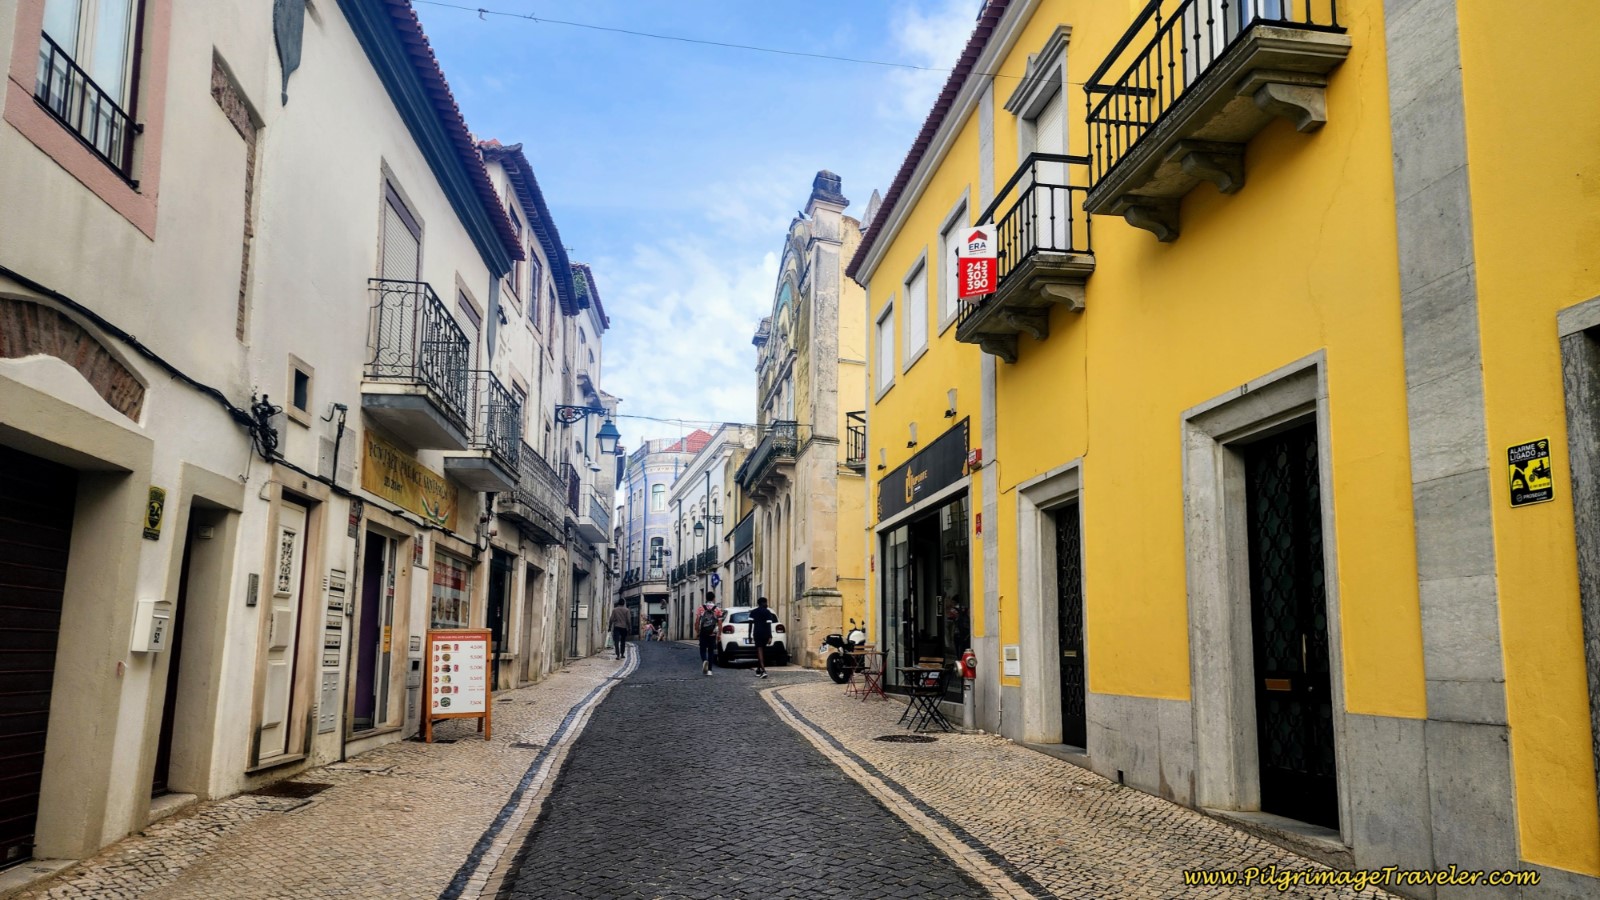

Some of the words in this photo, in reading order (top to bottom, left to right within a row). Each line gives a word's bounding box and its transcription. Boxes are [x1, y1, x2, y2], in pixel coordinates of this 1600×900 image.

[969, 242, 986, 250] ERA
[967, 260, 988, 273] 243
[967, 269, 988, 281] 303
[967, 278, 988, 290] 390
[1510, 444, 1535, 454] ALARME
[1510, 450, 1536, 461] LIGADO
[400, 461, 421, 485] PALACE
